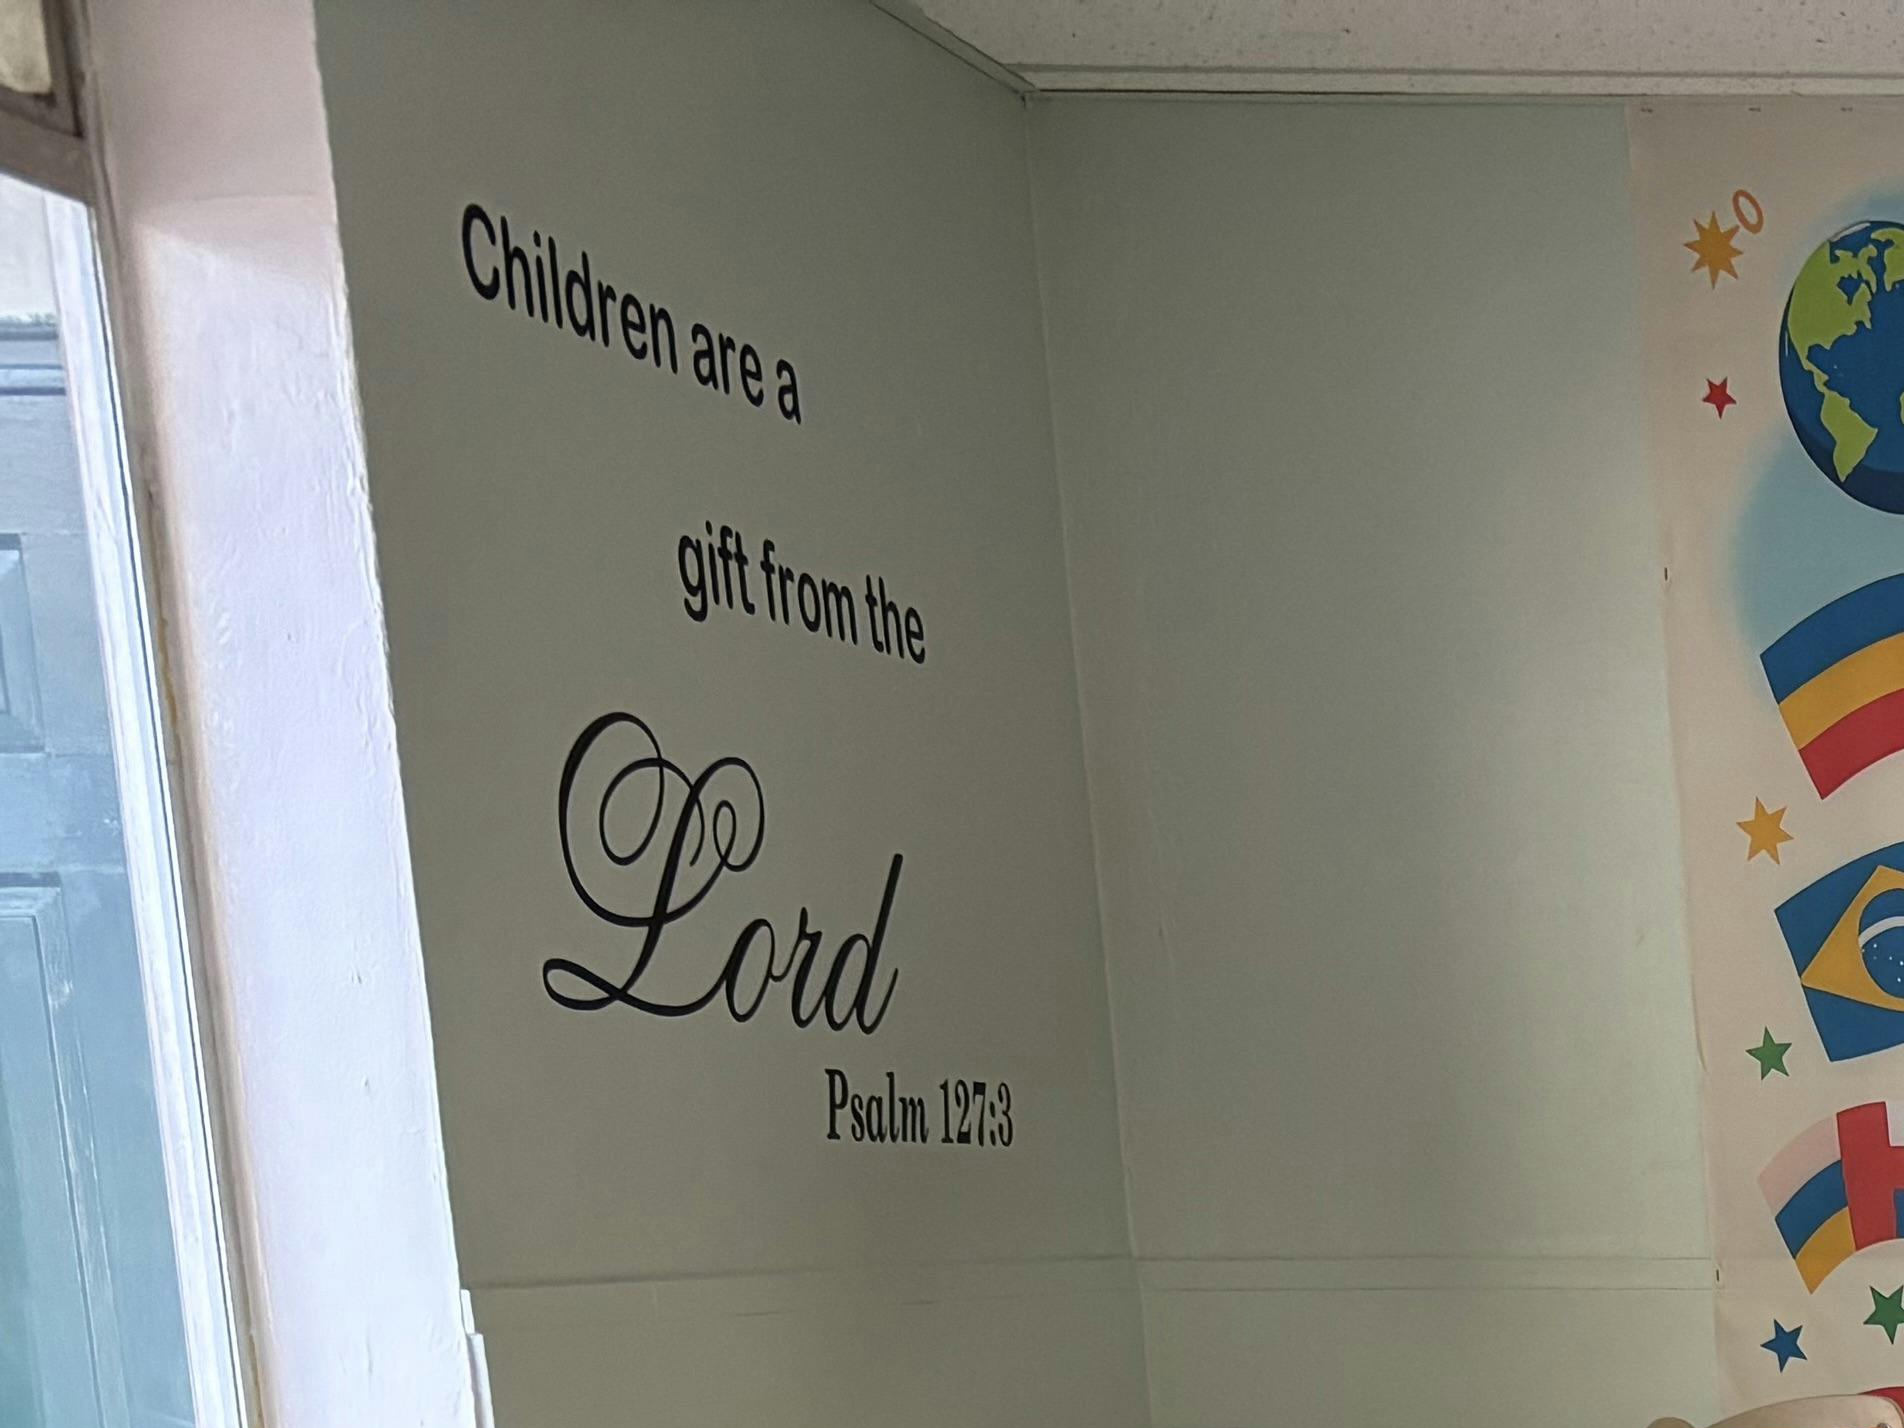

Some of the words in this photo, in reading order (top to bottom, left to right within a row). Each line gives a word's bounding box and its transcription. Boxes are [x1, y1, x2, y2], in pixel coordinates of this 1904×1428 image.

[462, 203, 678, 376] Children
[691, 323, 765, 408] are
[776, 358, 802, 426] a
[678, 520, 756, 623] gift
[760, 538, 858, 646] from
[865, 574, 926, 665] the
[543, 711, 904, 1036] Lord
[824, 1068, 929, 1144] Psalm
[939, 1078, 1013, 1147] 127:3
